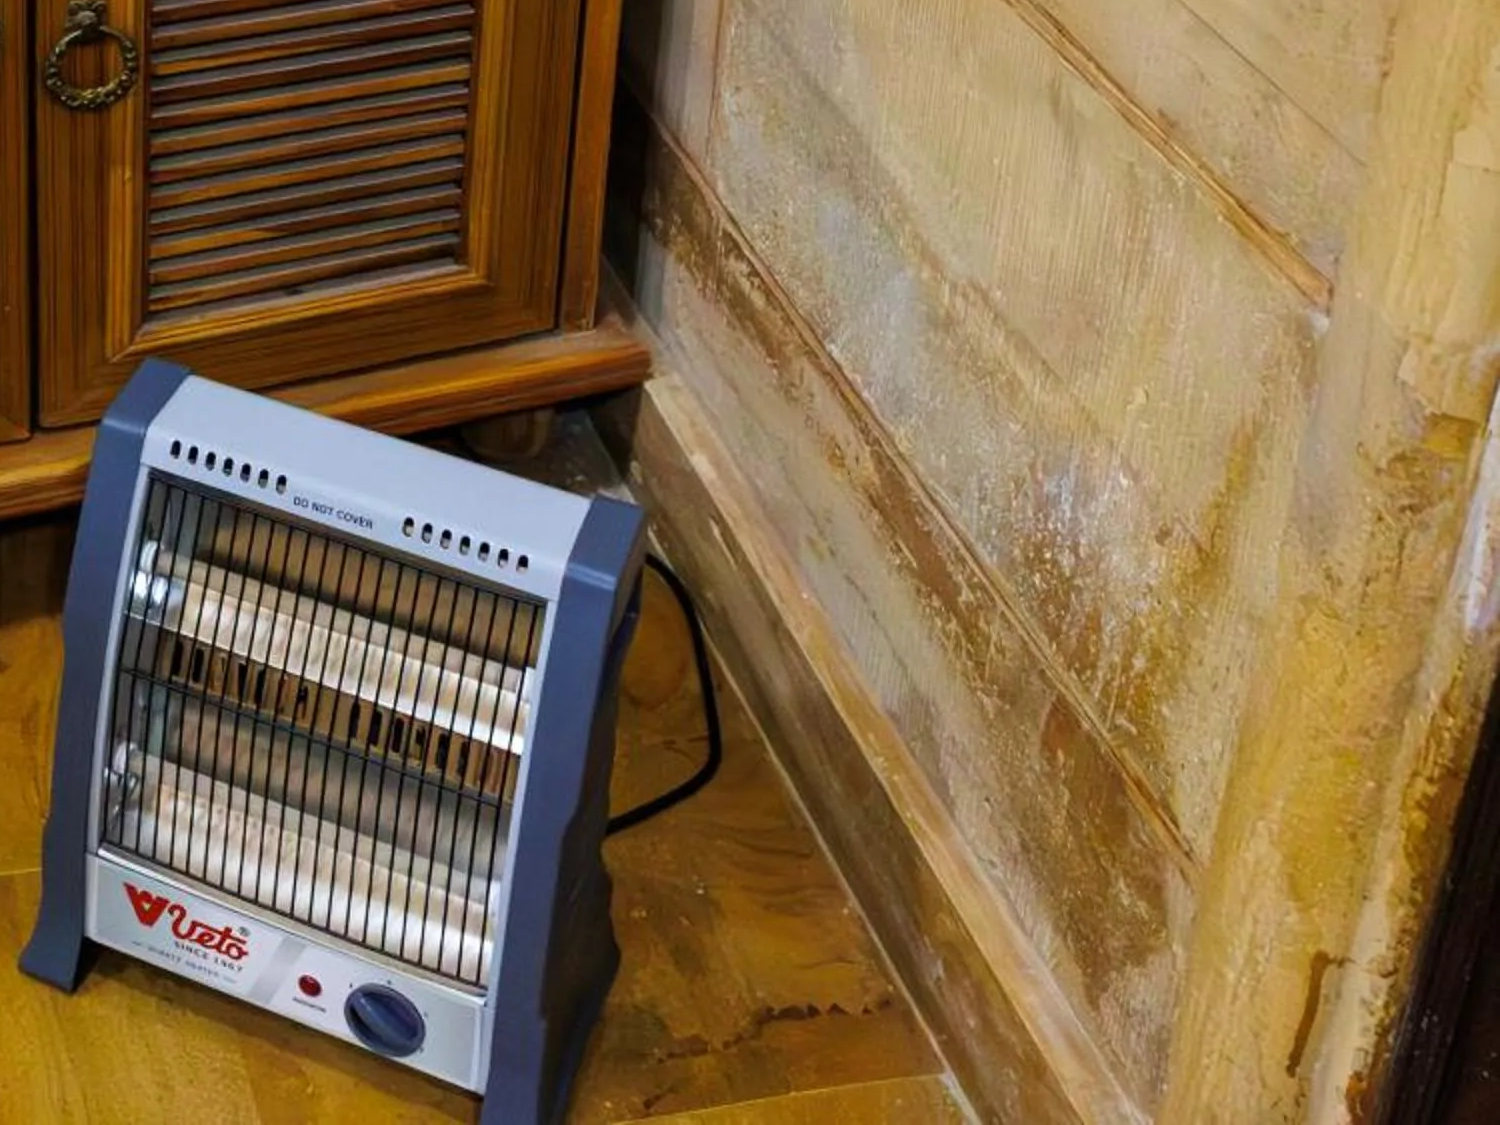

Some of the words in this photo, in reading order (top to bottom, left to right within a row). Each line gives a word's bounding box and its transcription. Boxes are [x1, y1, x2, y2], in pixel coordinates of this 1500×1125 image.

[293, 496, 309, 508] DO
[311, 501, 334, 516] NOT
[336, 509, 373, 530] COVER
[173, 940, 209, 960] SINCE
